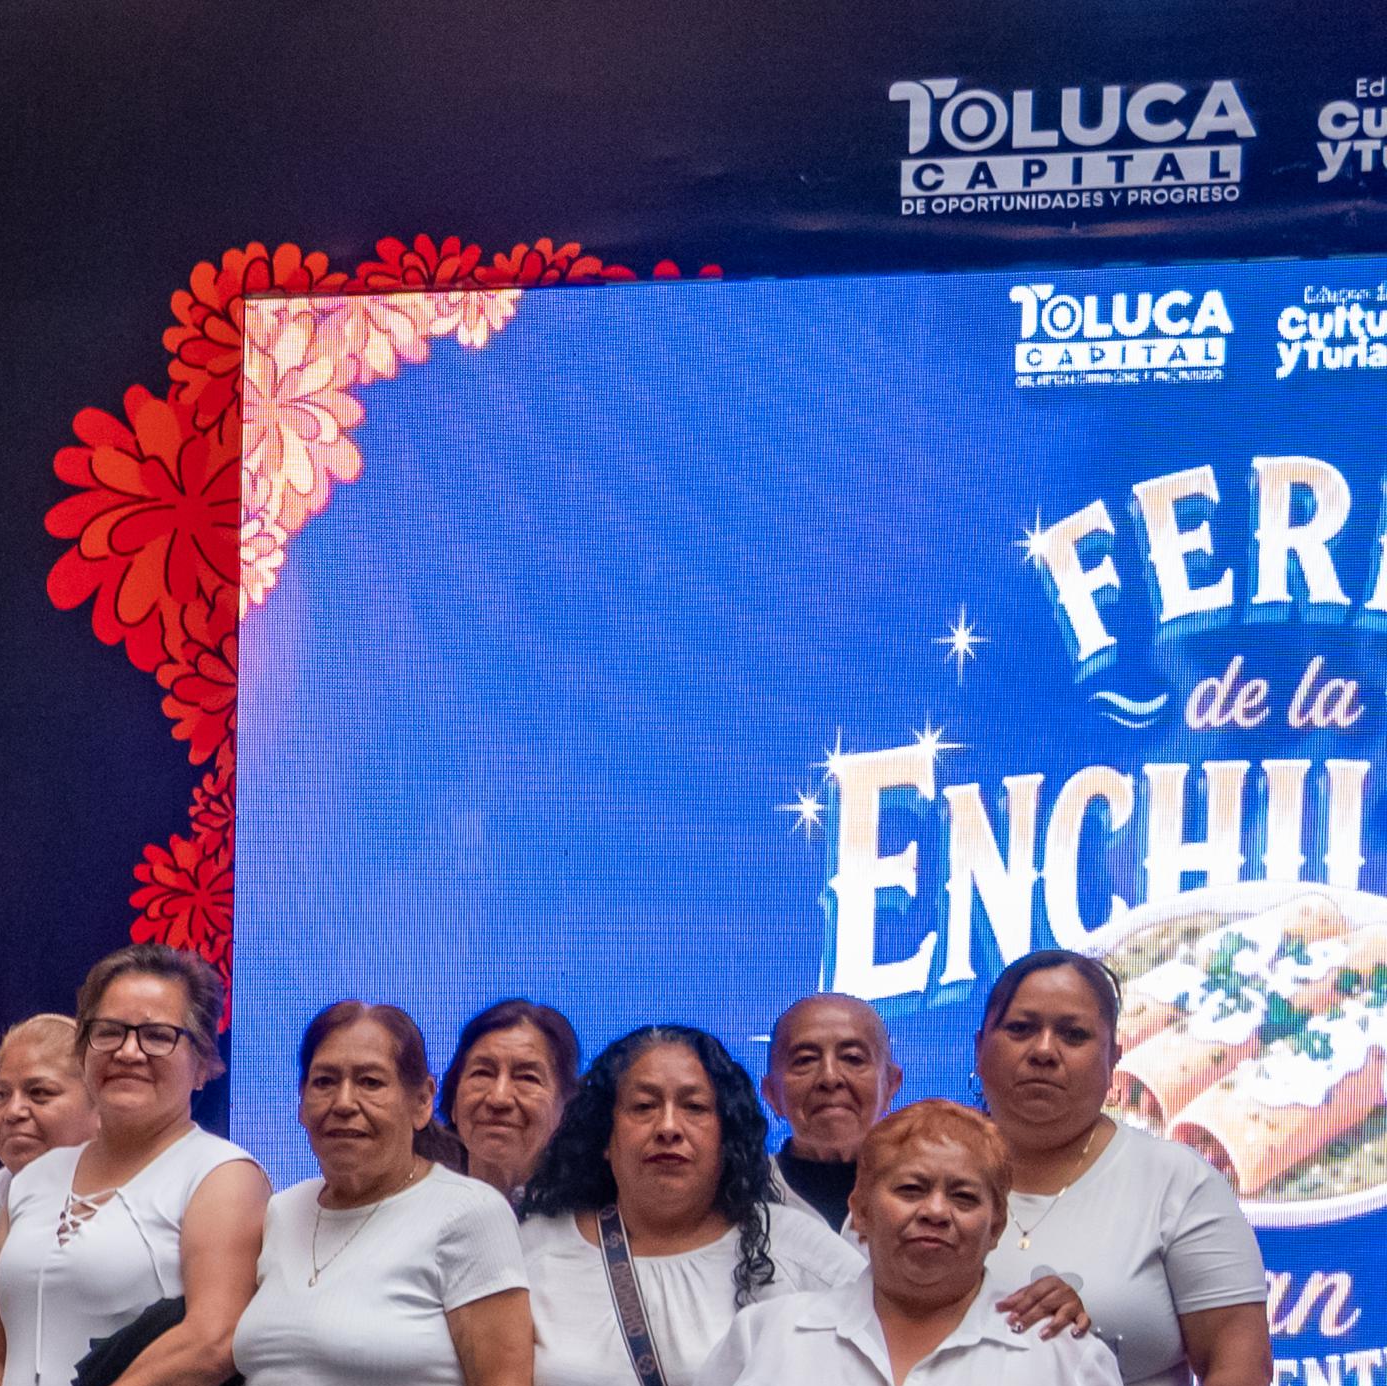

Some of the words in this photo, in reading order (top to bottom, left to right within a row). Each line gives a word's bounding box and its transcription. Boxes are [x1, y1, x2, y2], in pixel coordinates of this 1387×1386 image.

[888, 78, 1257, 155] TOLUCA
[901, 199, 926, 215] DE
[931, 191, 1104, 214] OPORTUNIDADES
[1109, 191, 1121, 206] Y
[1127, 185, 1240, 206] PROGRESO
[911, 150, 1232, 193] CAPITAL
[1009, 284, 1234, 341] TOLUCA
[1184, 656, 1271, 730] de
[1288, 656, 1365, 729] la
